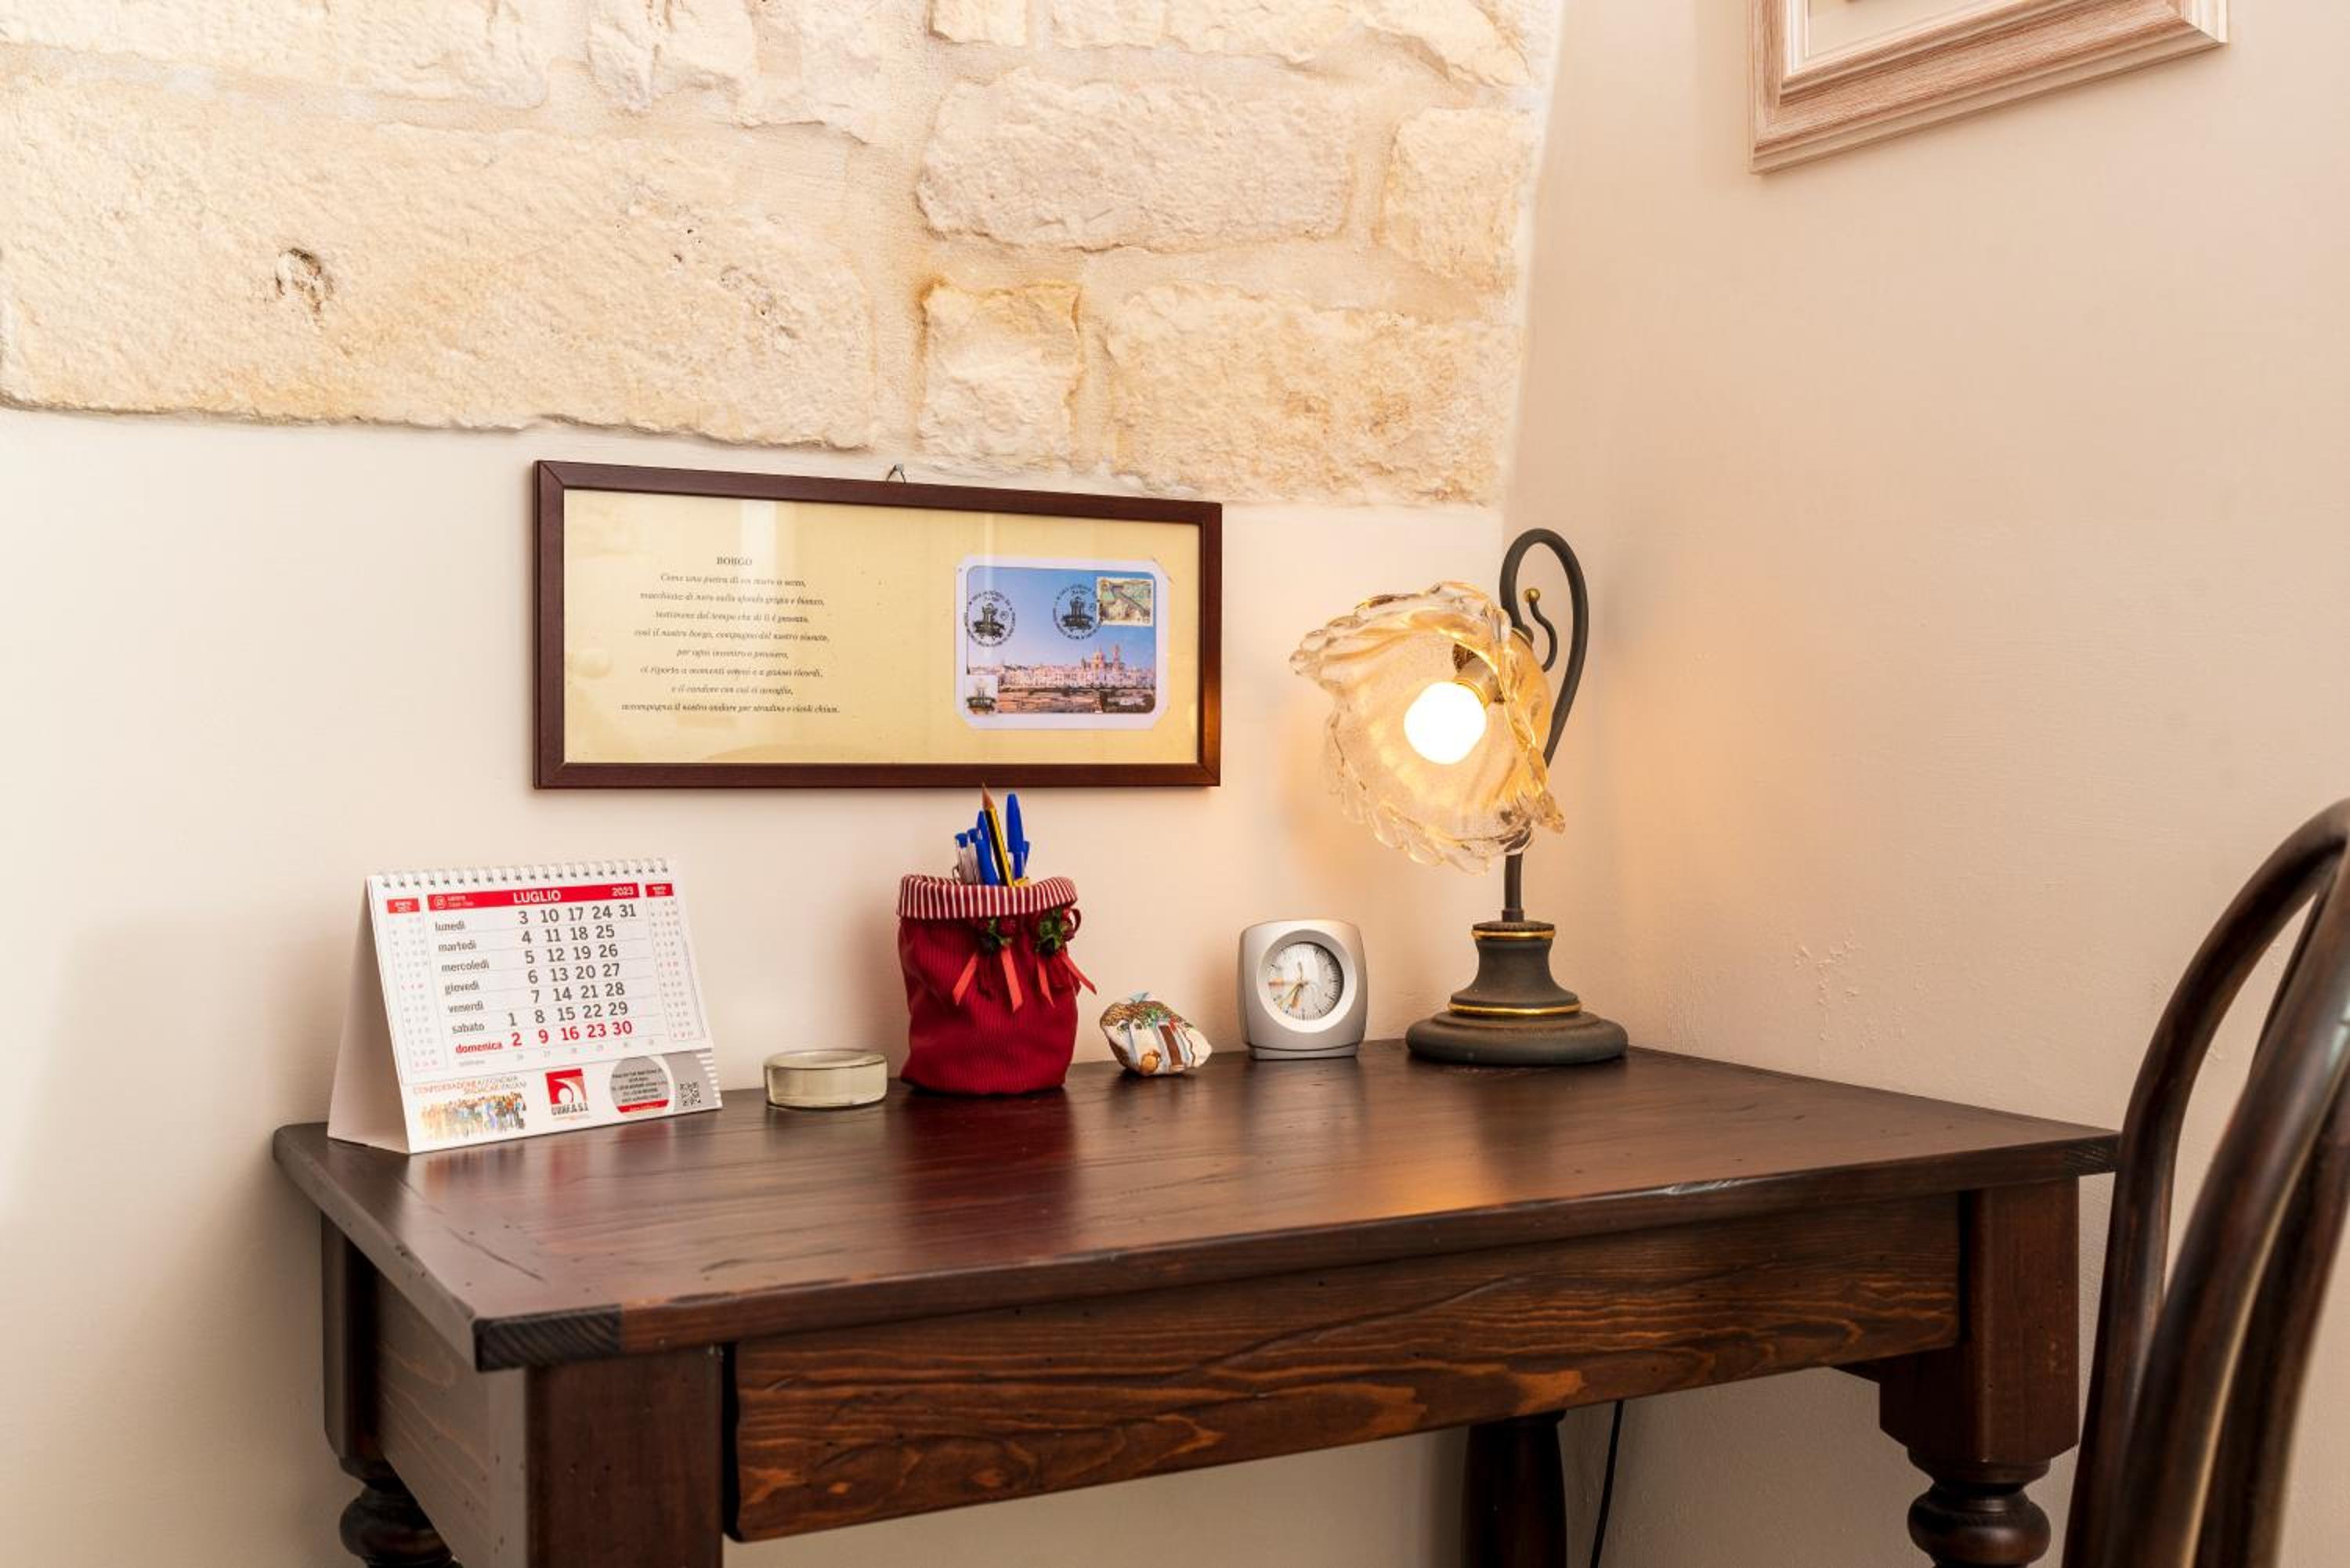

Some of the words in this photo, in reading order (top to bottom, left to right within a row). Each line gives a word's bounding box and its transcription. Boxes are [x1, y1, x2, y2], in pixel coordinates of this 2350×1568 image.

[716, 556, 753, 565] BORGO
[513, 890, 562, 904] LUGLIO
[611, 886, 634, 897] 2023
[435, 919, 465, 932] lunedì
[518, 910, 529, 925] 3
[540, 908, 559, 923] 10
[569, 906, 584, 922] 17
[591, 905, 613, 920] 24
[619, 903, 637, 918] 31
[438, 940, 477, 952] martedì
[522, 930, 532, 944] 4
[545, 928, 562, 942] 11
[570, 926, 589, 941] 18
[595, 924, 615, 939] 25
[441, 959, 490, 973] mercoledì
[525, 950, 535, 964] 5
[547, 948, 566, 963] 12
[573, 945, 591, 960] 19
[598, 944, 619, 959] 26
[444, 981, 480, 995] giovedì
[527, 969, 539, 985] 6
[550, 967, 569, 982] 13
[576, 964, 596, 980] 20
[602, 963, 620, 978] 27
[448, 1000, 484, 1013] venerdì
[530, 989, 540, 1004] 7
[553, 987, 573, 1002] 14
[580, 985, 598, 999] 21
[605, 981, 626, 997] 28
[452, 1023, 485, 1035] sabato
[508, 1012, 518, 1027] 1
[535, 1009, 546, 1024] 8
[557, 1006, 577, 1022] 15
[582, 1004, 603, 1019] 22
[608, 1001, 628, 1017] 29
[455, 1041, 504, 1054] domenica
[511, 1031, 522, 1047] 2
[538, 1028, 549, 1044] 9
[560, 1025, 580, 1042] 16
[586, 1023, 607, 1039] 23
[612, 1020, 633, 1036] 30
